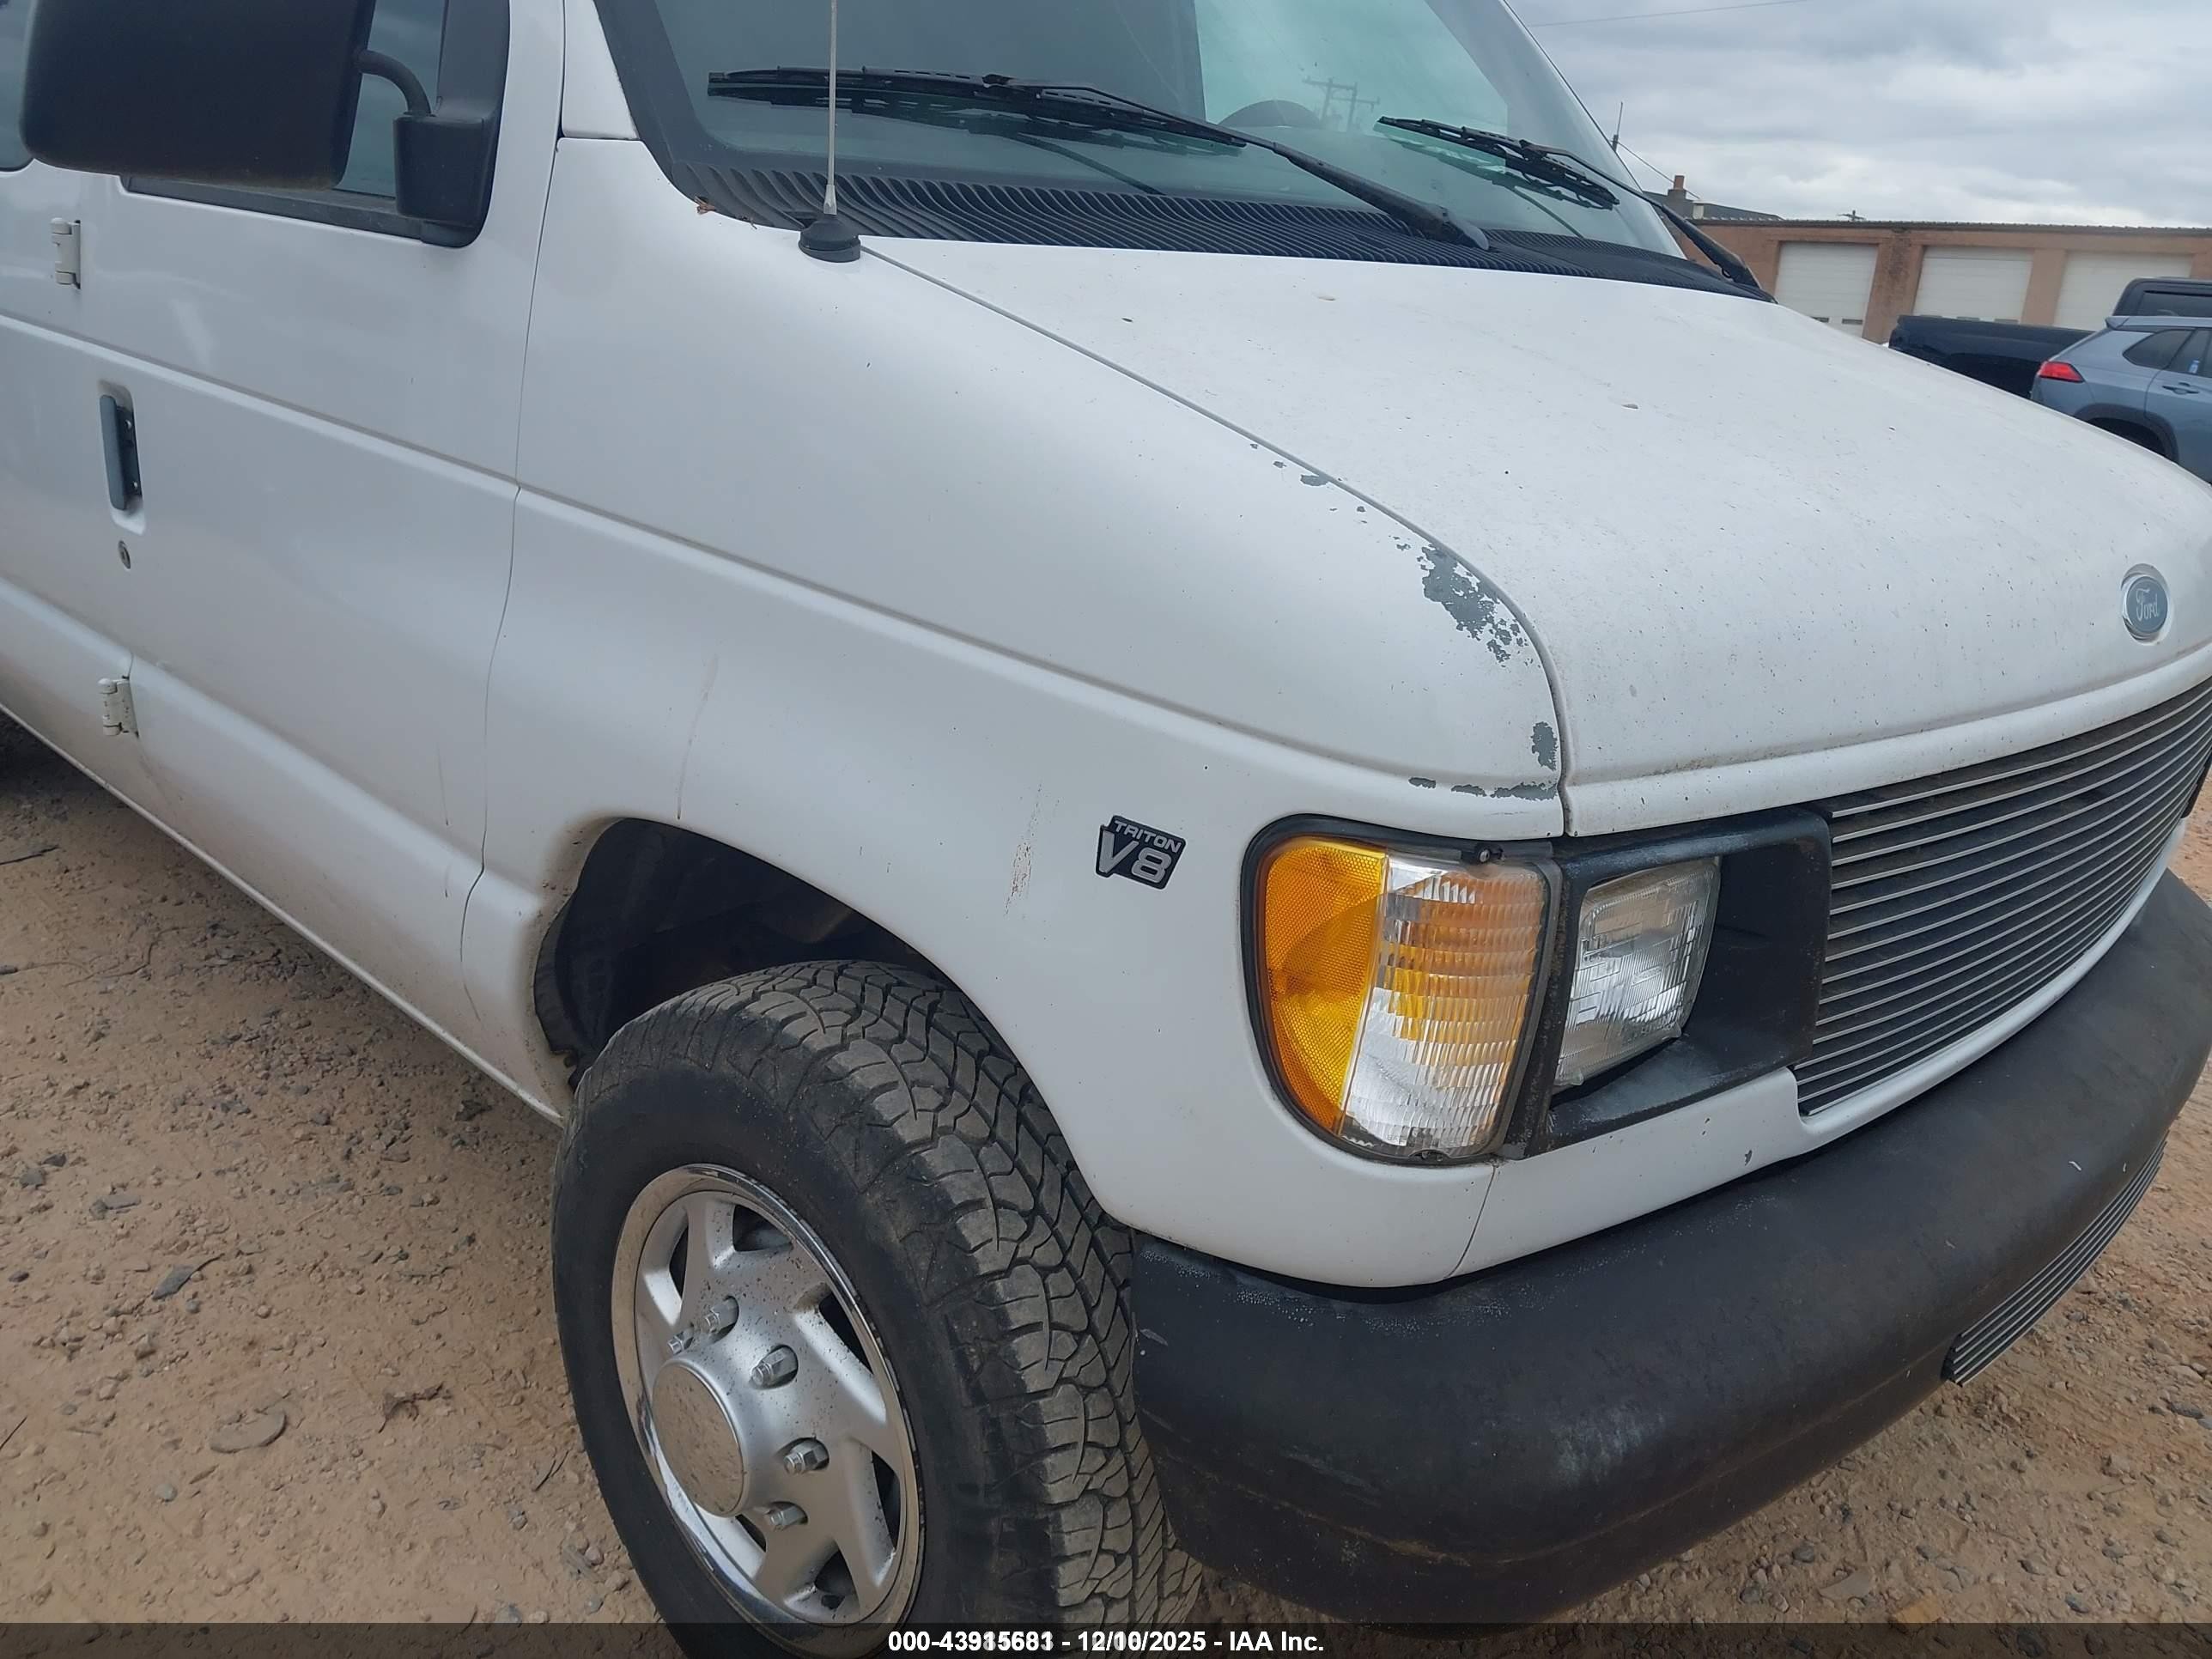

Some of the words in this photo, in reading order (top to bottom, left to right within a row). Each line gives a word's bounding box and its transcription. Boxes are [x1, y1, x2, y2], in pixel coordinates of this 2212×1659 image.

[2136, 587, 2160, 622] Ford
[1115, 819, 1182, 854] TRITON
[1098, 830, 1172, 884] V8
